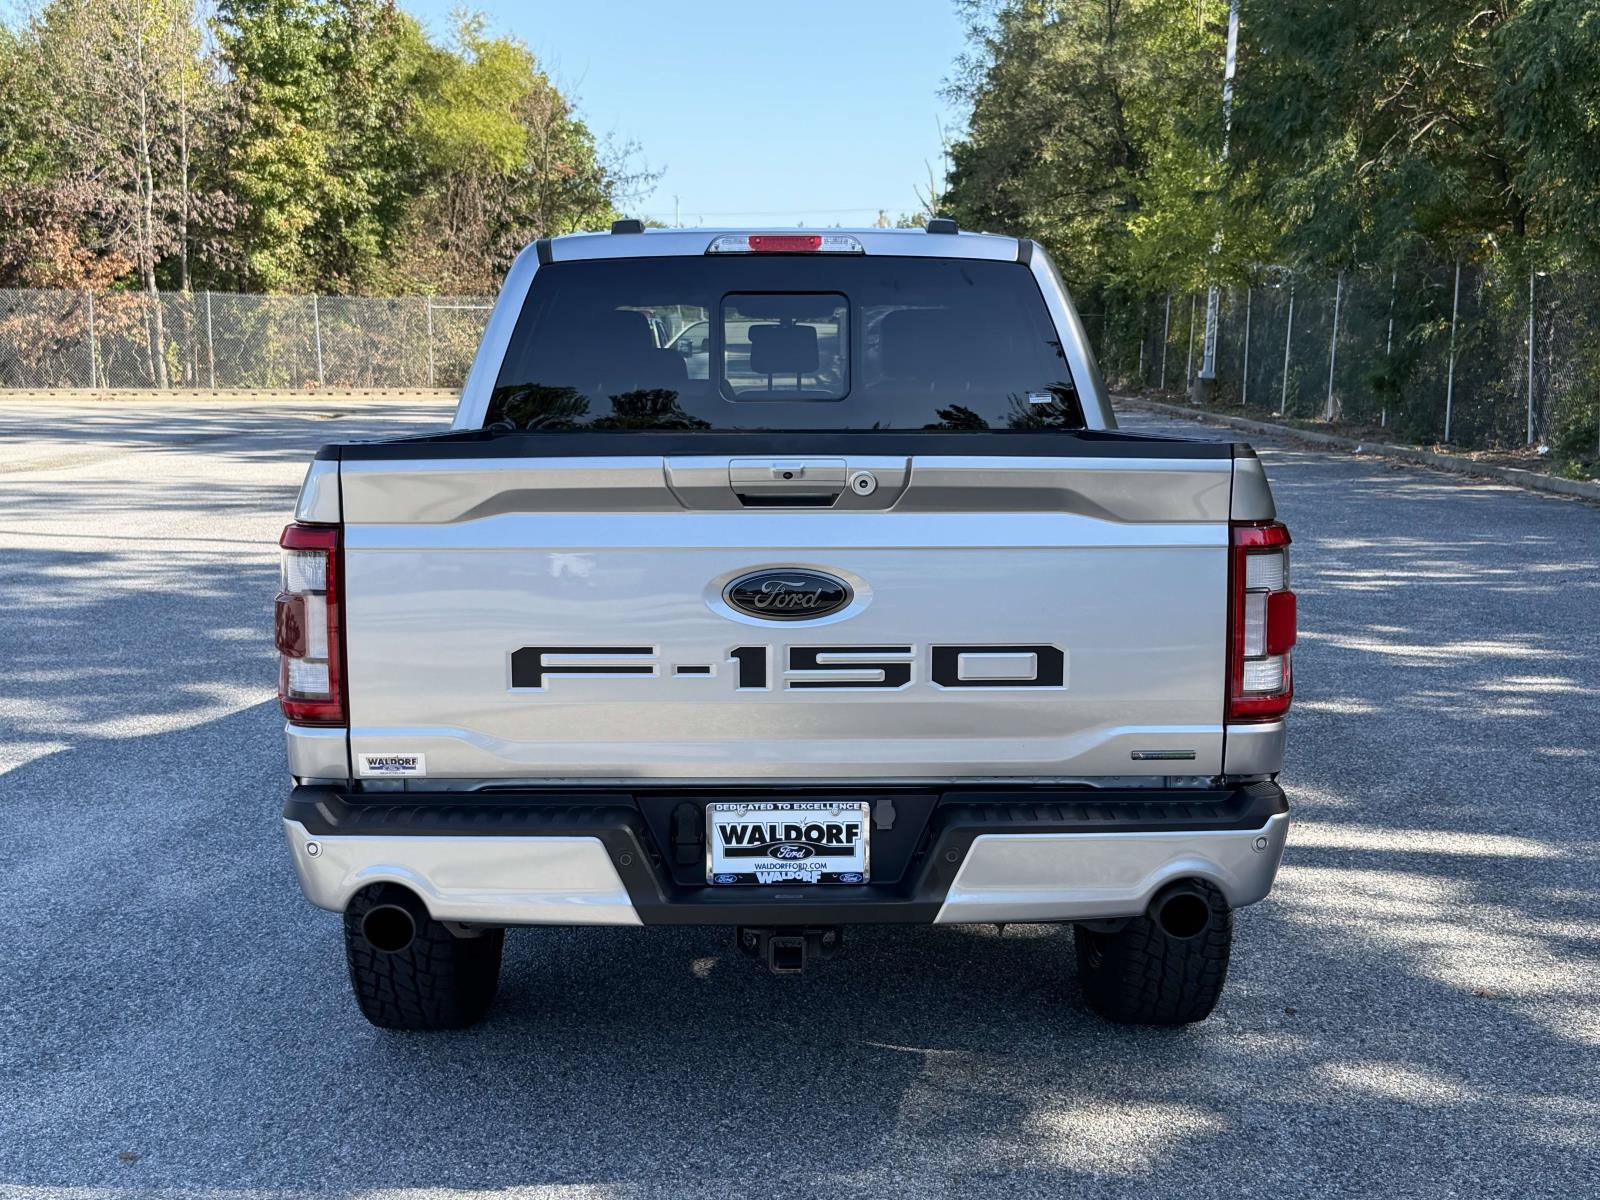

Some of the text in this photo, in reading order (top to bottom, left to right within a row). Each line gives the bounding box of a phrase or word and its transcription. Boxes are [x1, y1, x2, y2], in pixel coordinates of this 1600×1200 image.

[754, 580, 822, 608] Ford
[510, 645, 1065, 689] F-150
[716, 803, 774, 811] DEDICATED
[718, 823, 859, 845] WALDORF
[777, 845, 806, 858] Ford
[754, 862, 828, 870] WALDORFFORD.COM
[755, 870, 822, 884] WALDORF
